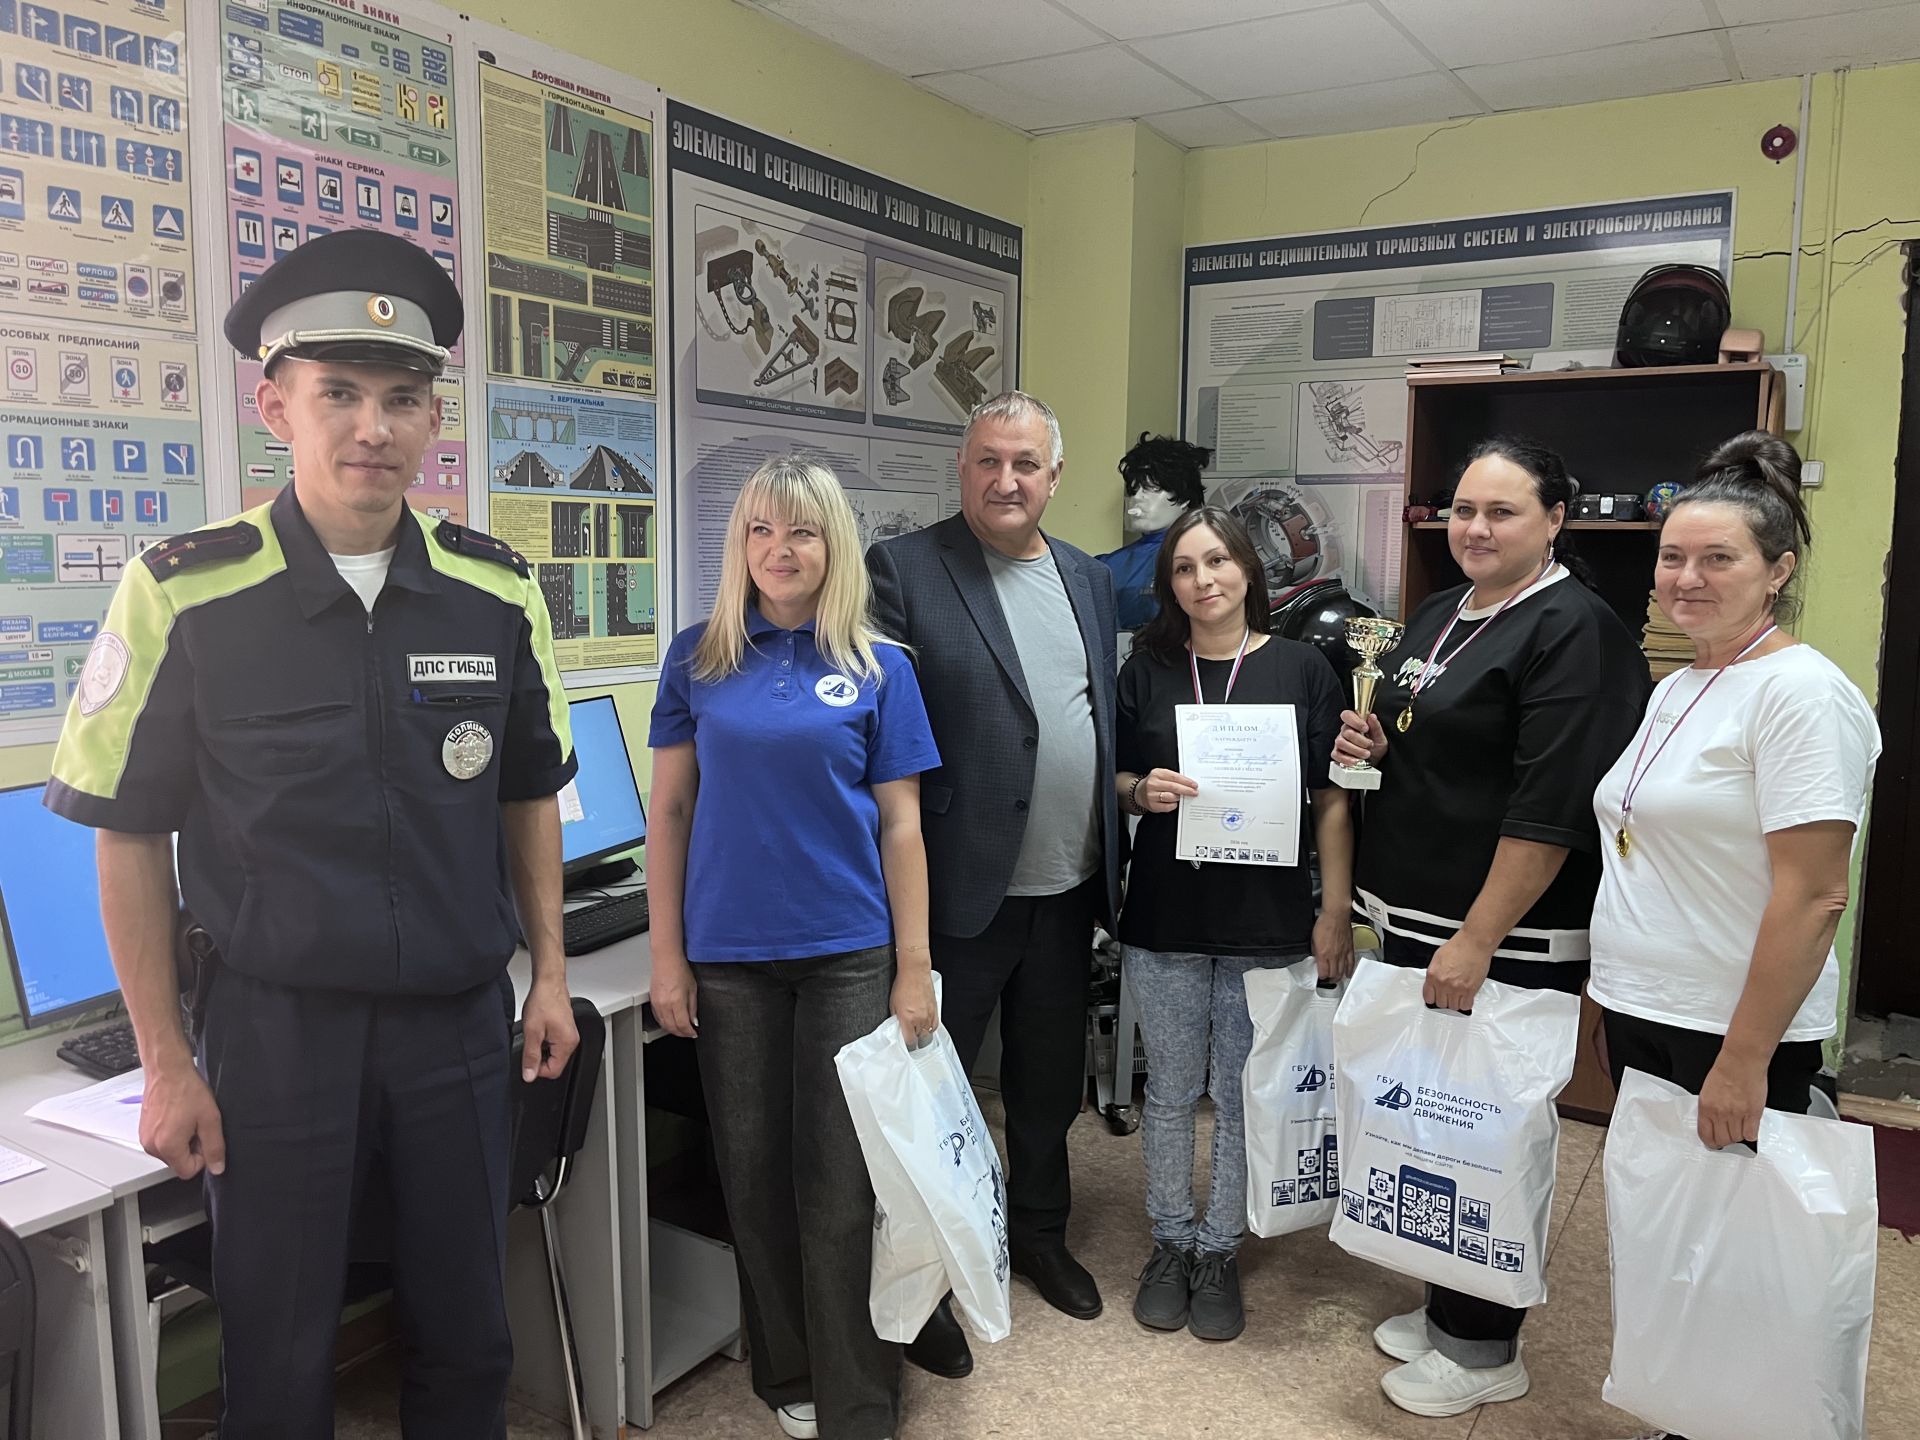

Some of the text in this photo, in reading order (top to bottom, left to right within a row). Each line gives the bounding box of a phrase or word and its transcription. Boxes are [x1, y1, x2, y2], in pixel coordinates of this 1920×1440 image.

[286, 0, 371, 32] ИНФОРМАЦИОННЫЕ
[373, 26, 400, 41] ЗНАКИ
[363, 4, 400, 25] ЗНАКИ
[282, 66, 309, 80] СТОП
[532, 69, 612, 104] ДОРОЖНАЯ РАЗМЕТКА
[548, 90, 605, 116] ГОРИЗОНТАЛЬНАЯ
[315, 153, 385, 176] ЗНАКИ СЕРВИСА
[672, 120, 1019, 260] ЭЛЕМЕНТЫ СОЕДИНИТЕЛЬНЫХ УЗЛОВ ТЯГАЧА И ПРИЦЕПА
[1192, 206, 1722, 273] ЭЛЕМЕНТЫ СОЕДИНИТЕЛЬНЫХ ТОРМОЗНЫХ СИСТЕМ И ЭЛЕКТРООБОРУДОВАНИЯ
[79, 265, 115, 278] ОРЛОВО
[129, 266, 146, 274] ЗОНА
[0, 328, 141, 350] ОСОБЫХ ПРЕДПИСАНИЙ
[15, 364, 29, 374] 30
[557, 395, 605, 408] ВЕРТИКАЛЬНАЯ
[0, 414, 129, 430] ОРМАЦИОННЫЕ ЗНАКИ
[43, 631, 79, 639] БЕЛГОРОД
[14, 669, 41, 678] МОСКВА
[413, 660, 495, 677] ДПС ГИБДД
[447, 722, 490, 742] ПОЛИЦИЯ
[1212, 725, 1259, 733] ДИПЛОМ
[1292, 1064, 1308, 1072] ГБУ
[1376, 1074, 1395, 1085] ГБУ
[1414, 1097, 1484, 1121] ДОРОЖНОГО
[1417, 1086, 1502, 1114] БЕЗОПАСНОСТЬ
[1413, 1108, 1474, 1131] ДВИЖЕНИЯ
[1364, 1130, 1390, 1143] Узнайте,
[1390, 1138, 1402, 1147] как
[1412, 1147, 1436, 1158] делаем
[1437, 1154, 1461, 1164] дороги
[1462, 1159, 1503, 1175] безопаснее
